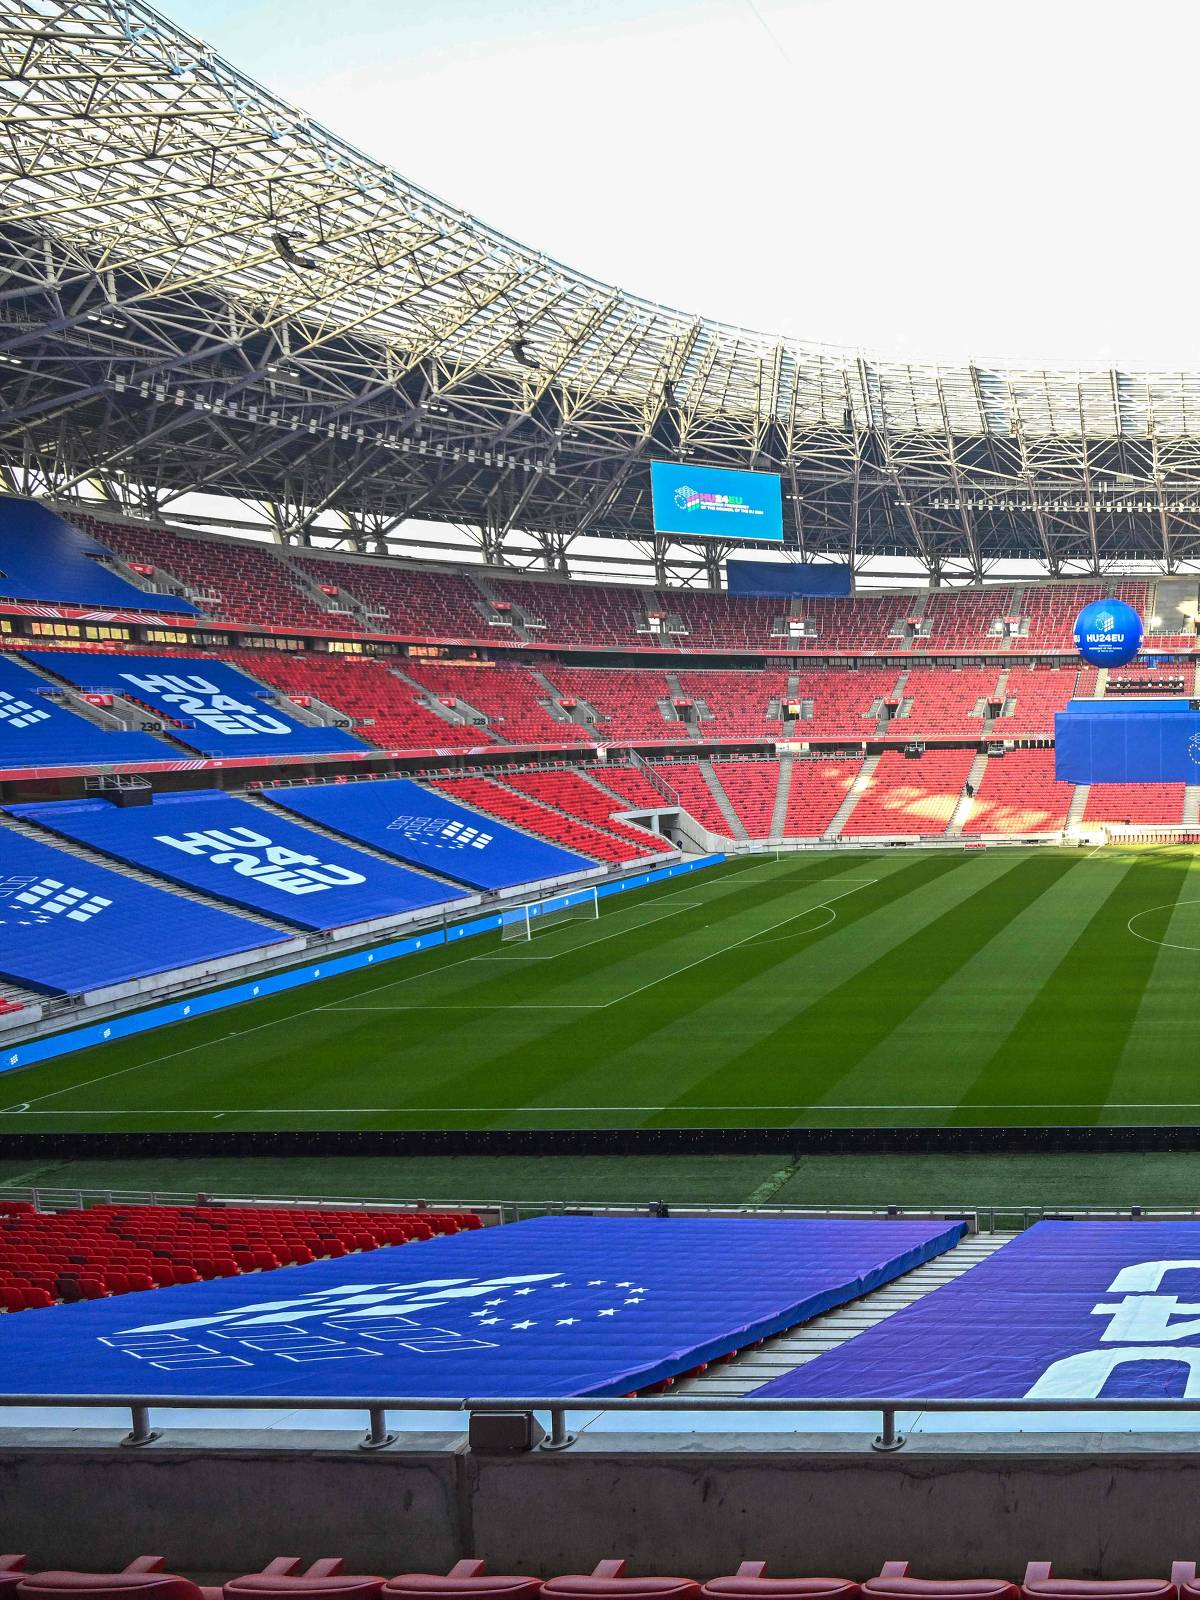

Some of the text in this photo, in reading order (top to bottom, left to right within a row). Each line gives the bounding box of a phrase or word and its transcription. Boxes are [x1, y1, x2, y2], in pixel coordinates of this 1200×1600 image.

[701, 494, 743, 504] HU24EU
[1087, 634, 1125, 642] HU24EU
[118, 673, 220, 694] HU
[161, 694, 258, 714] 24
[140, 722, 161, 731] 230
[193, 714, 292, 735] EU
[152, 827, 273, 856] HU
[209, 846, 322, 876] 24
[252, 864, 367, 895] EU
